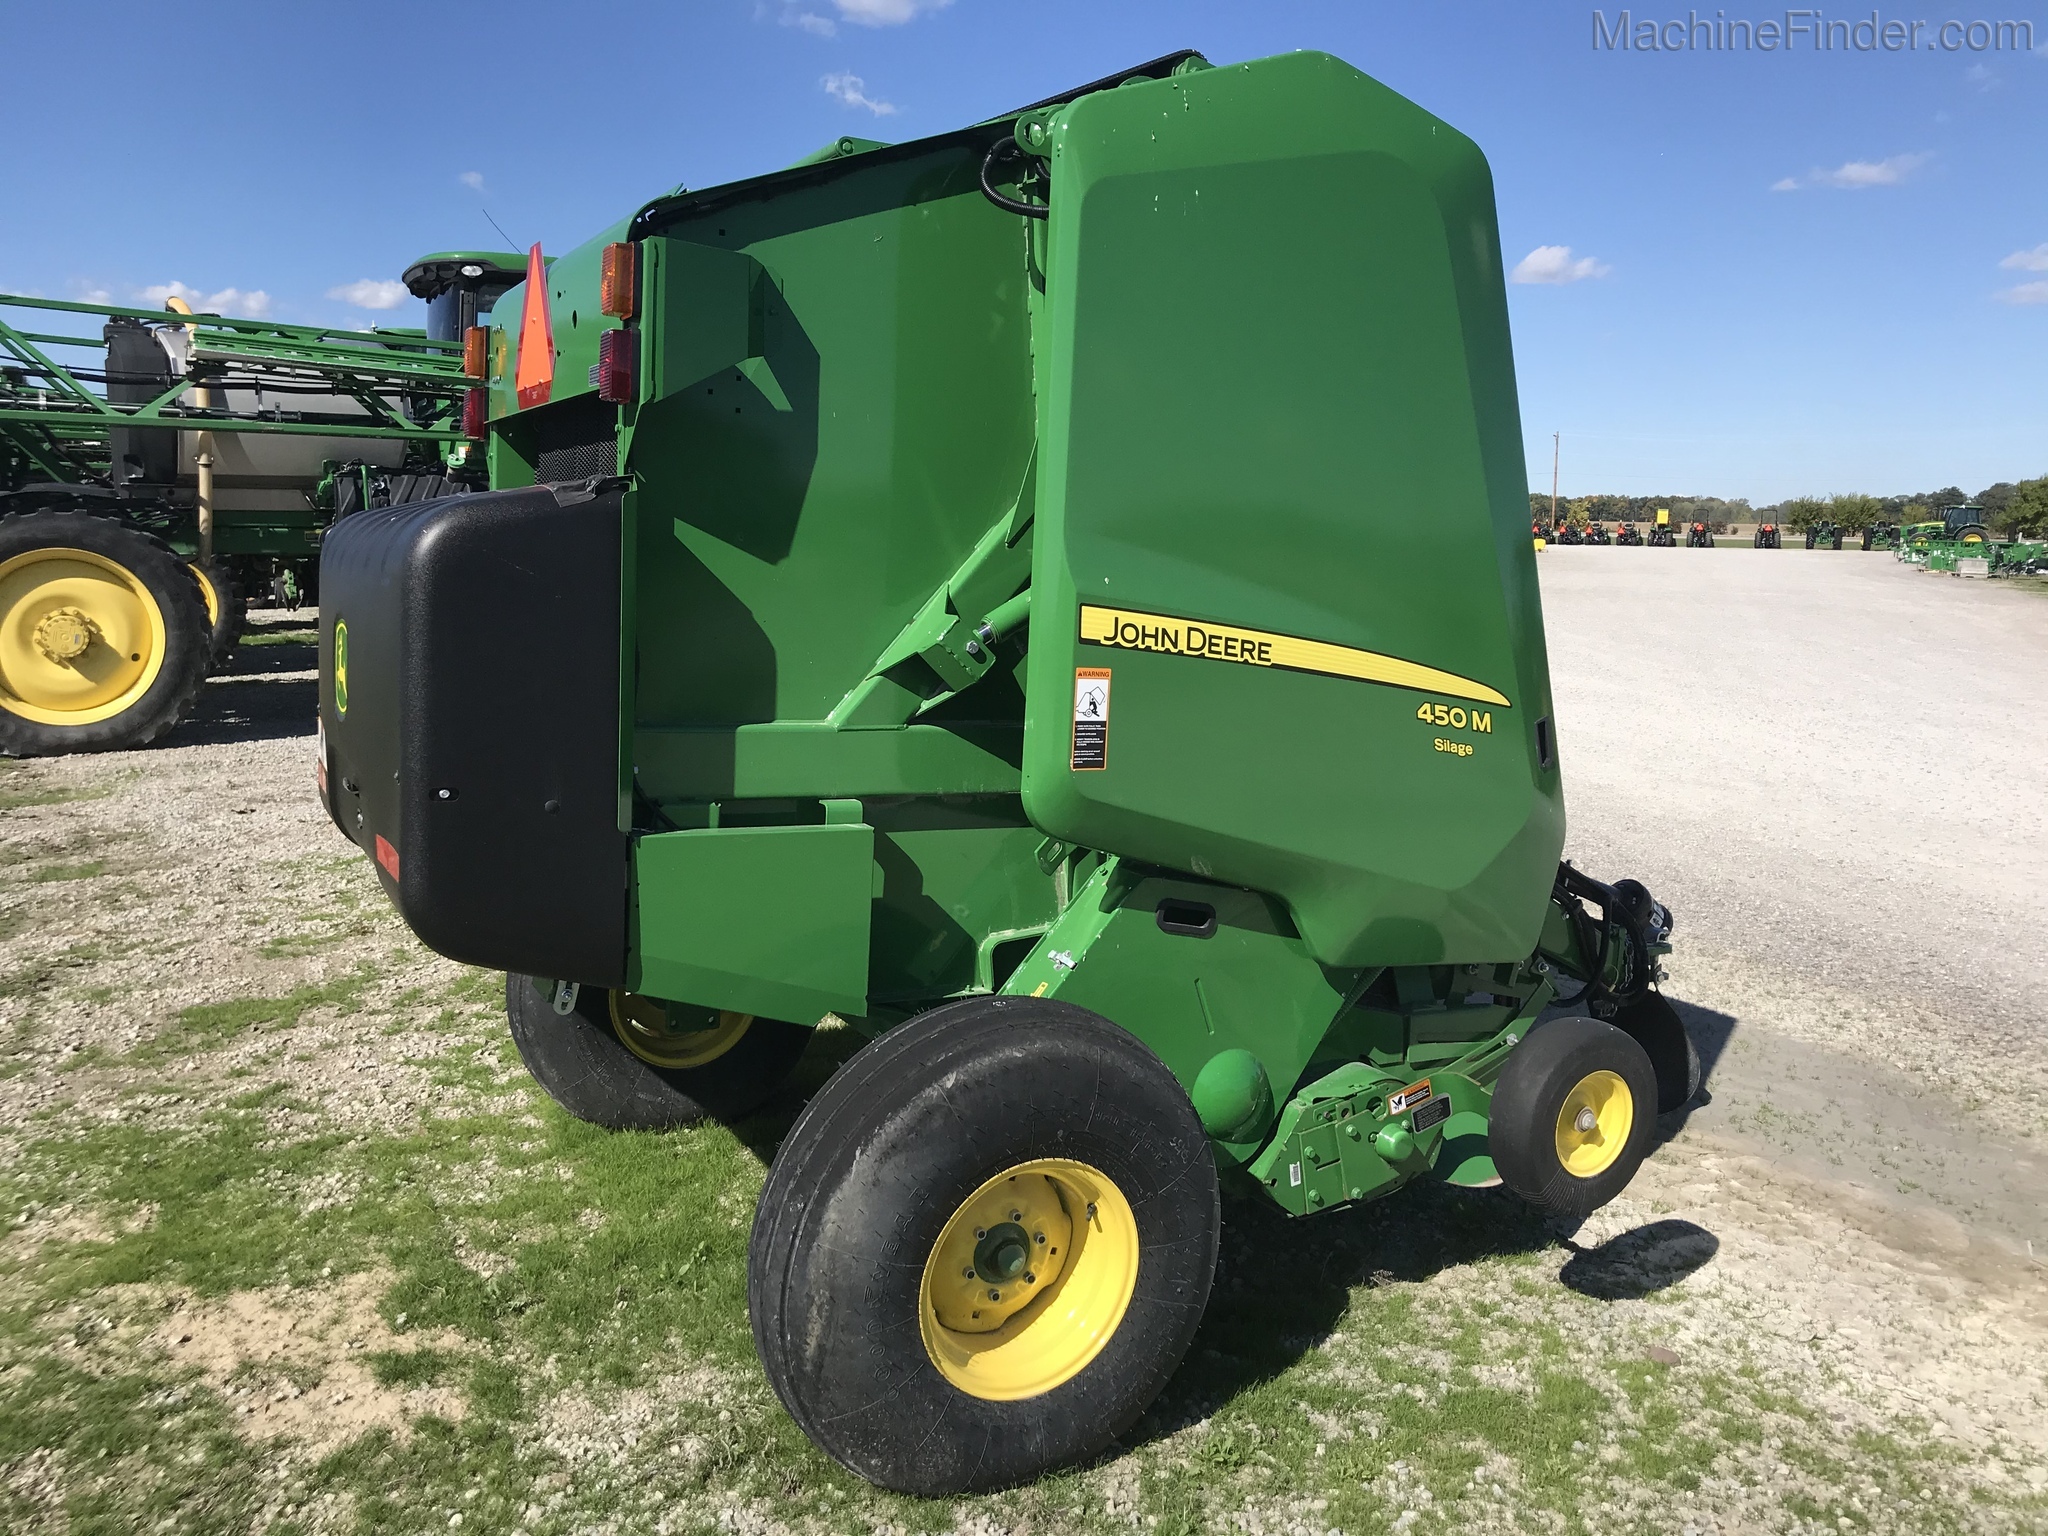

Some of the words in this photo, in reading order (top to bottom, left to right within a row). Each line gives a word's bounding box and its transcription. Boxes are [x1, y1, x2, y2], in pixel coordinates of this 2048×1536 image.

[1103, 617, 1179, 649] JOHN
[1186, 626, 1272, 663] DEERE
[1082, 670, 1110, 678] WARNING
[1416, 701, 1468, 729] 450
[1471, 709, 1492, 734] M
[1433, 737, 1474, 757] Silage
